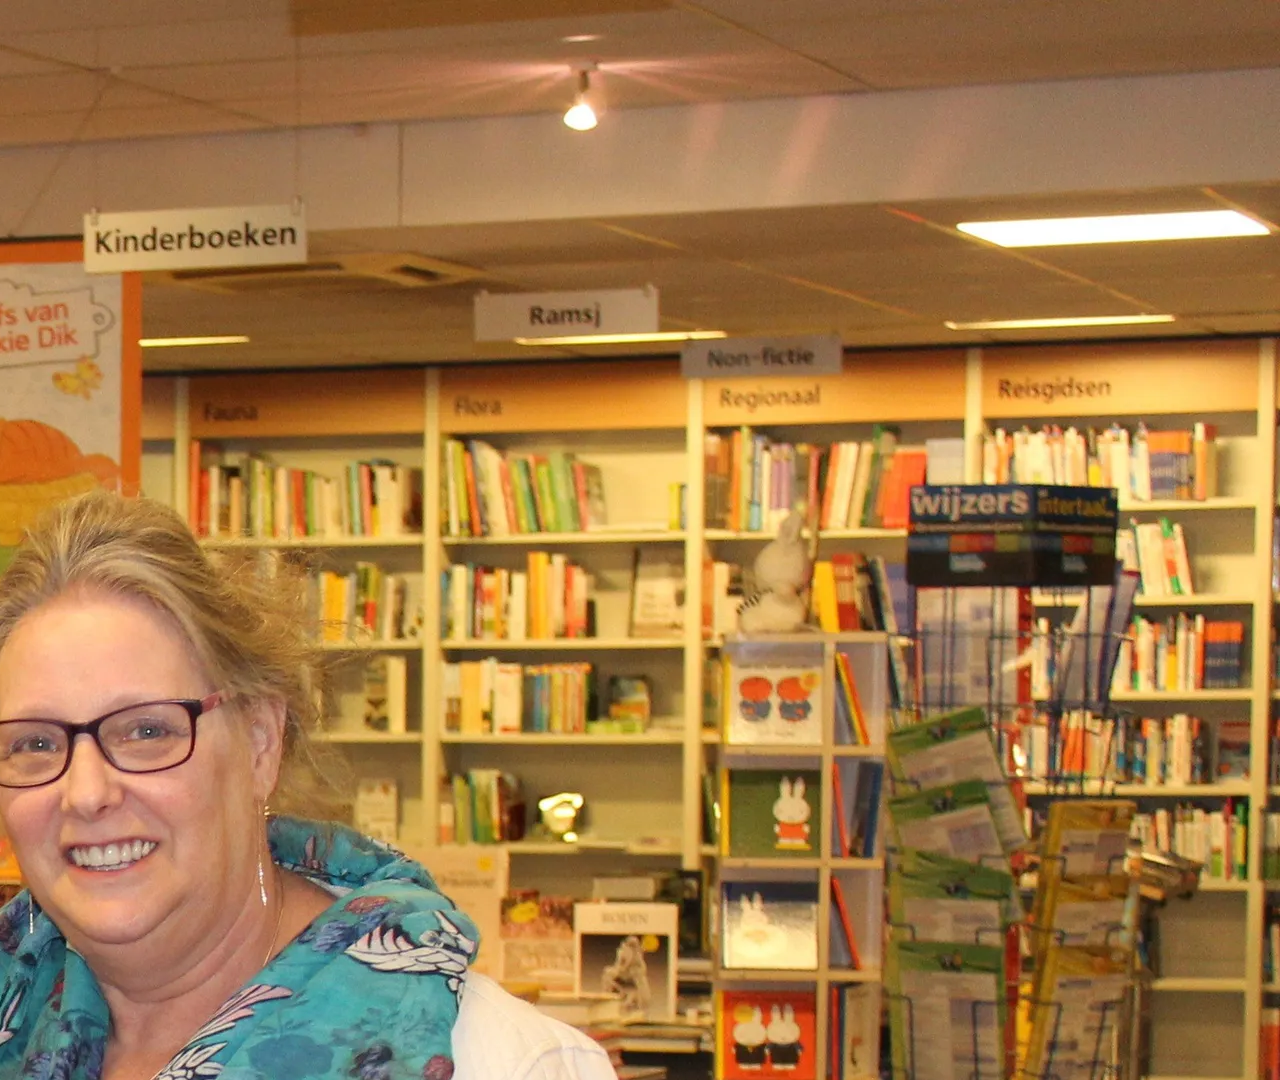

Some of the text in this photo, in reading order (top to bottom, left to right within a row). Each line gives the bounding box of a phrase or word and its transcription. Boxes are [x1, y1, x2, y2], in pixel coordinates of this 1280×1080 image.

[95, 223, 297, 255] Kinderboeken
[26, 303, 70, 322] van
[529, 303, 601, 328] Ramsj
[37, 325, 79, 350] Dik
[707, 347, 815, 369] Non-fictie
[720, 384, 821, 413] Regionaal
[998, 376, 1112, 403] Reisgidsen
[204, 403, 259, 423] Fauna
[454, 397, 503, 417] Flora
[911, 488, 1030, 522] wijzers
